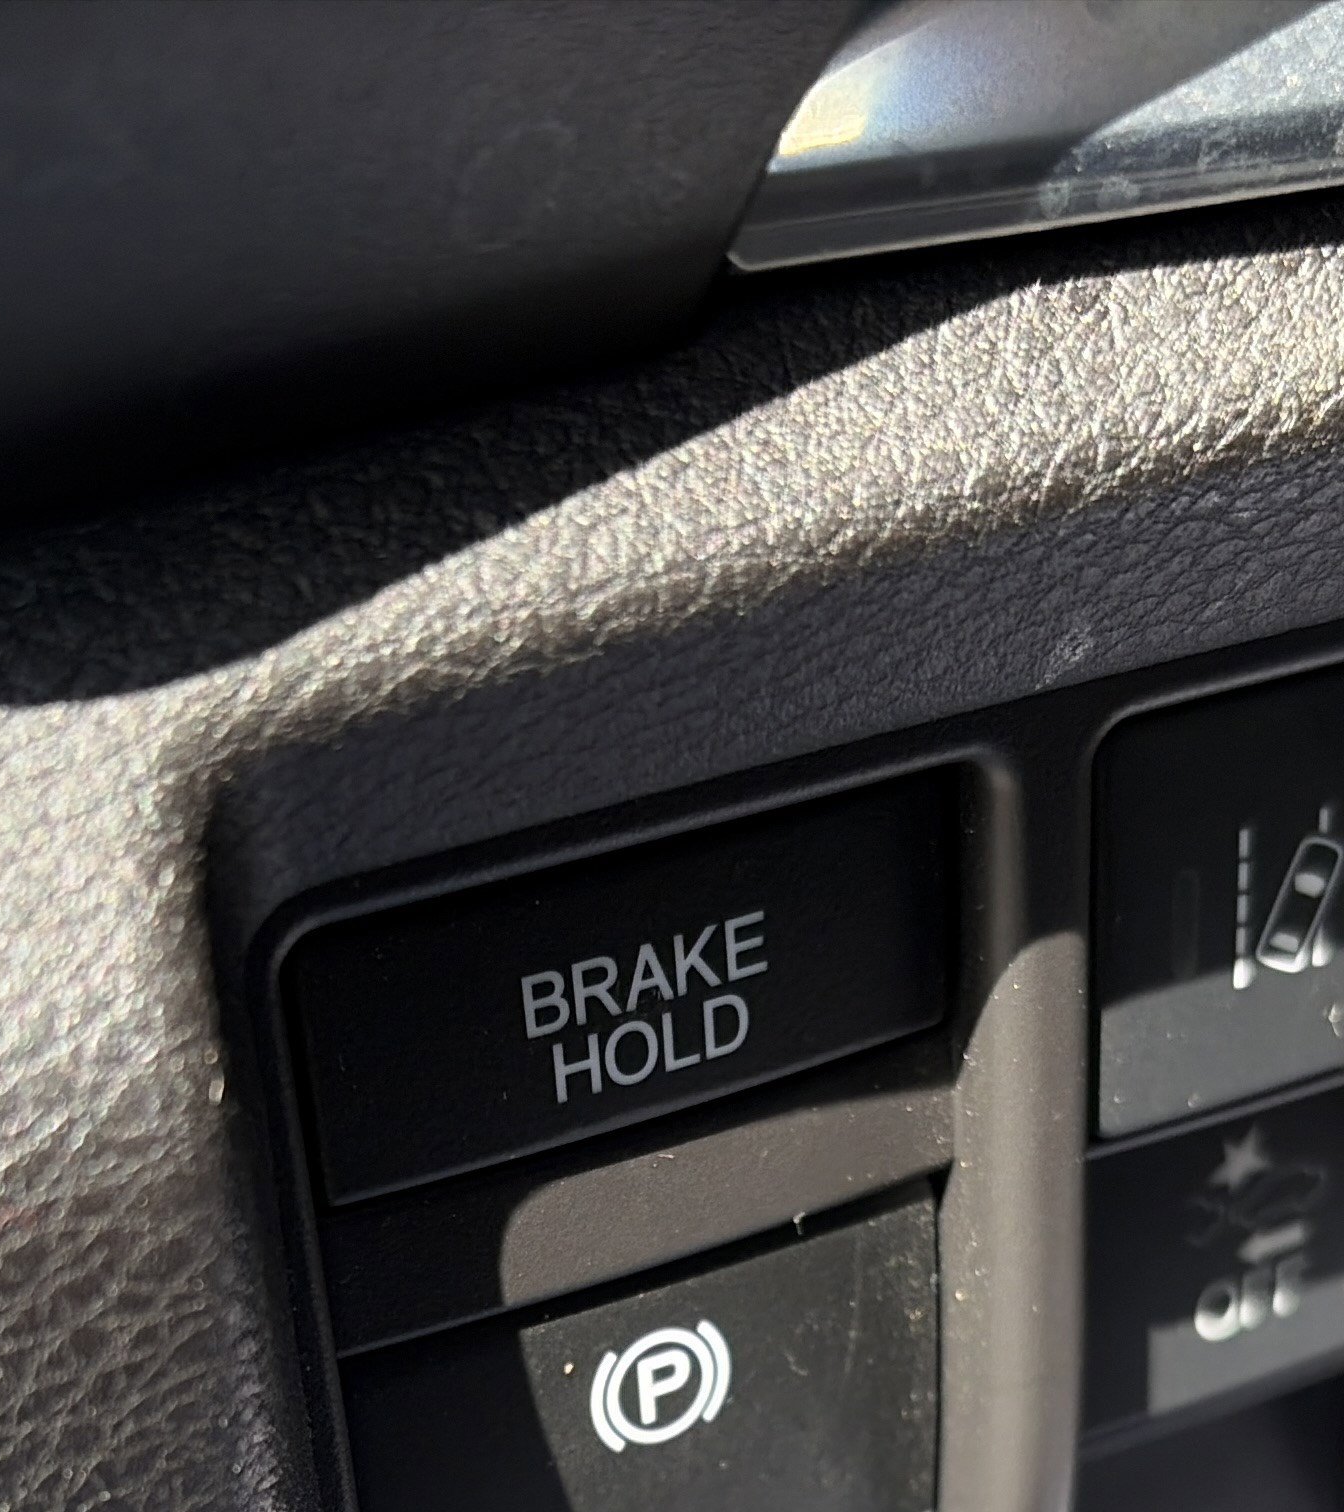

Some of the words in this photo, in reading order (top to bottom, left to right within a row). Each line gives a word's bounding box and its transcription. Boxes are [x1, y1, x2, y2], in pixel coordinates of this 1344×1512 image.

[521, 910, 768, 1039] BRAKE
[553, 994, 749, 1103] HOLD
[637, 1348, 690, 1425] P
